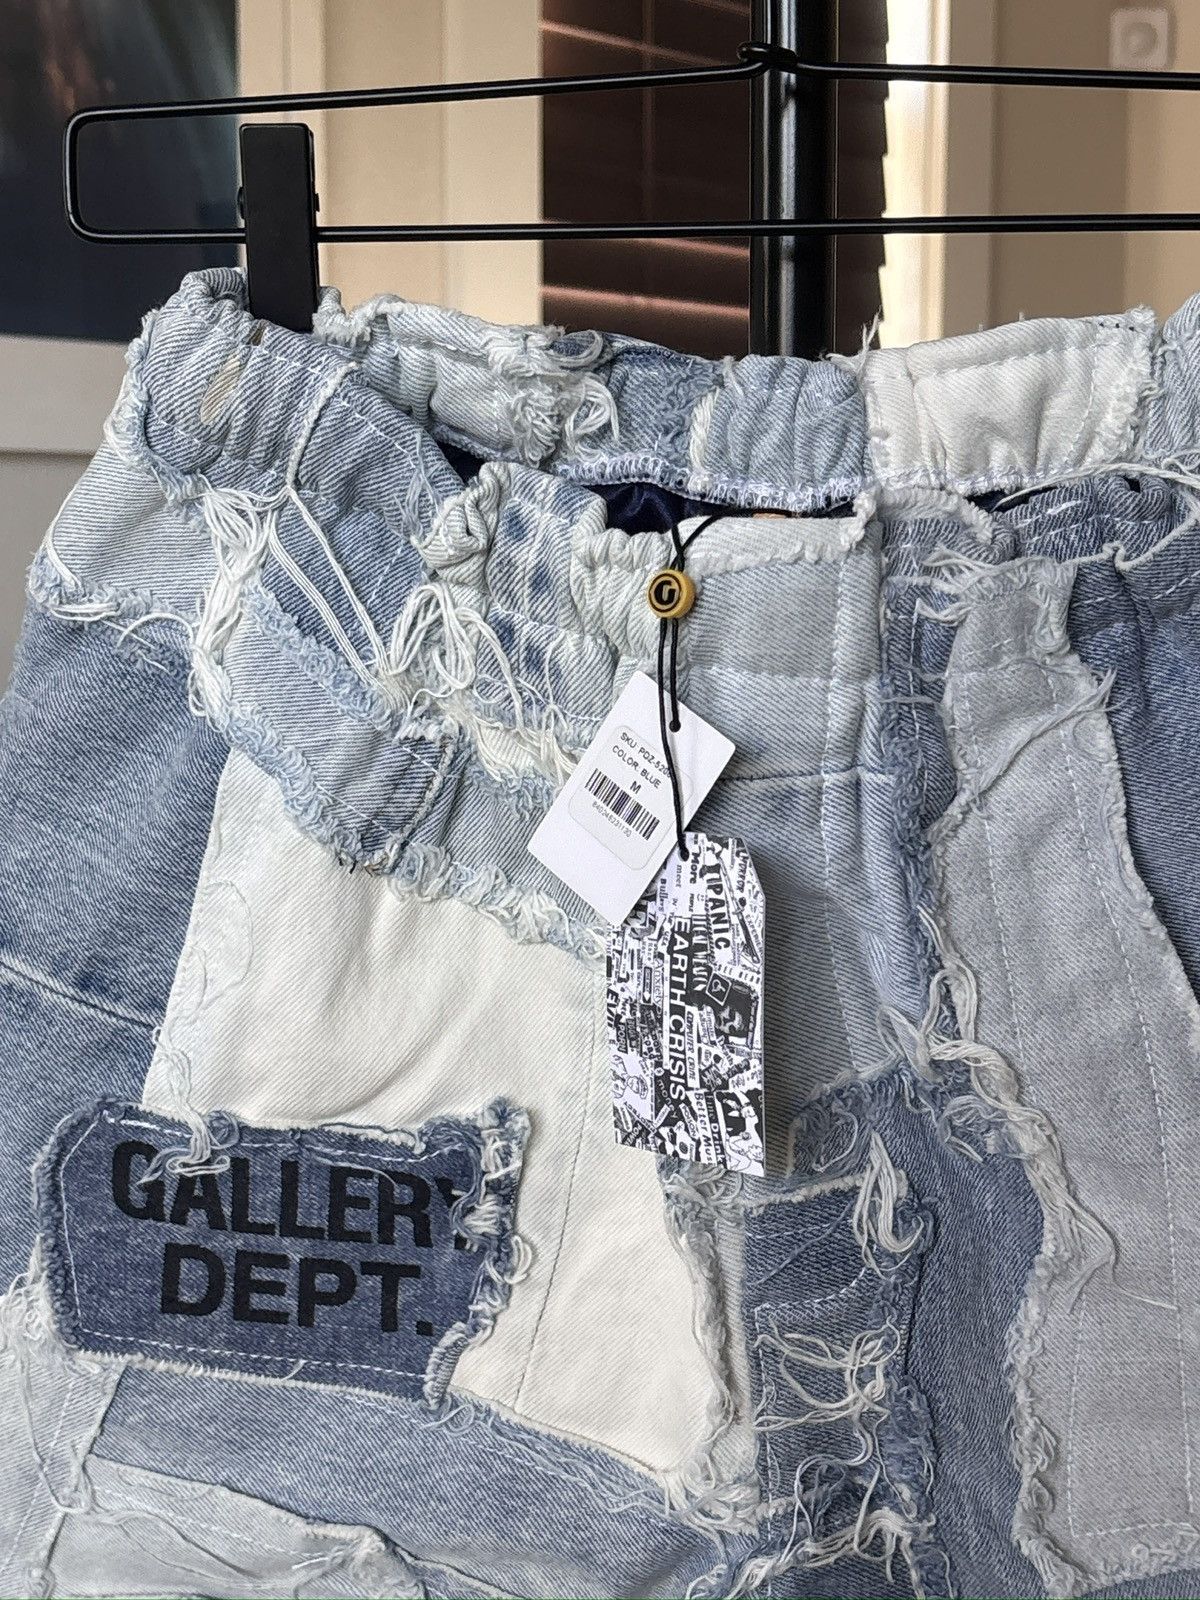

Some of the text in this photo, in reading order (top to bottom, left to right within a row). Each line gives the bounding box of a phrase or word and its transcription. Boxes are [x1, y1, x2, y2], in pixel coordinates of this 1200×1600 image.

[653, 579, 677, 606] G
[629, 780, 642, 795] M
[640, 768, 662, 789] BLUE
[707, 883, 731, 950] PANIC
[653, 959, 664, 1006] Anxiety
[669, 917, 691, 1100] EARTH CRISIS
[617, 1024, 627, 1051] PORN
[686, 1010, 696, 1080] COMPUTER CRIME
[694, 1092, 709, 1132] Better
[160, 1241, 434, 1337] DEPT.
